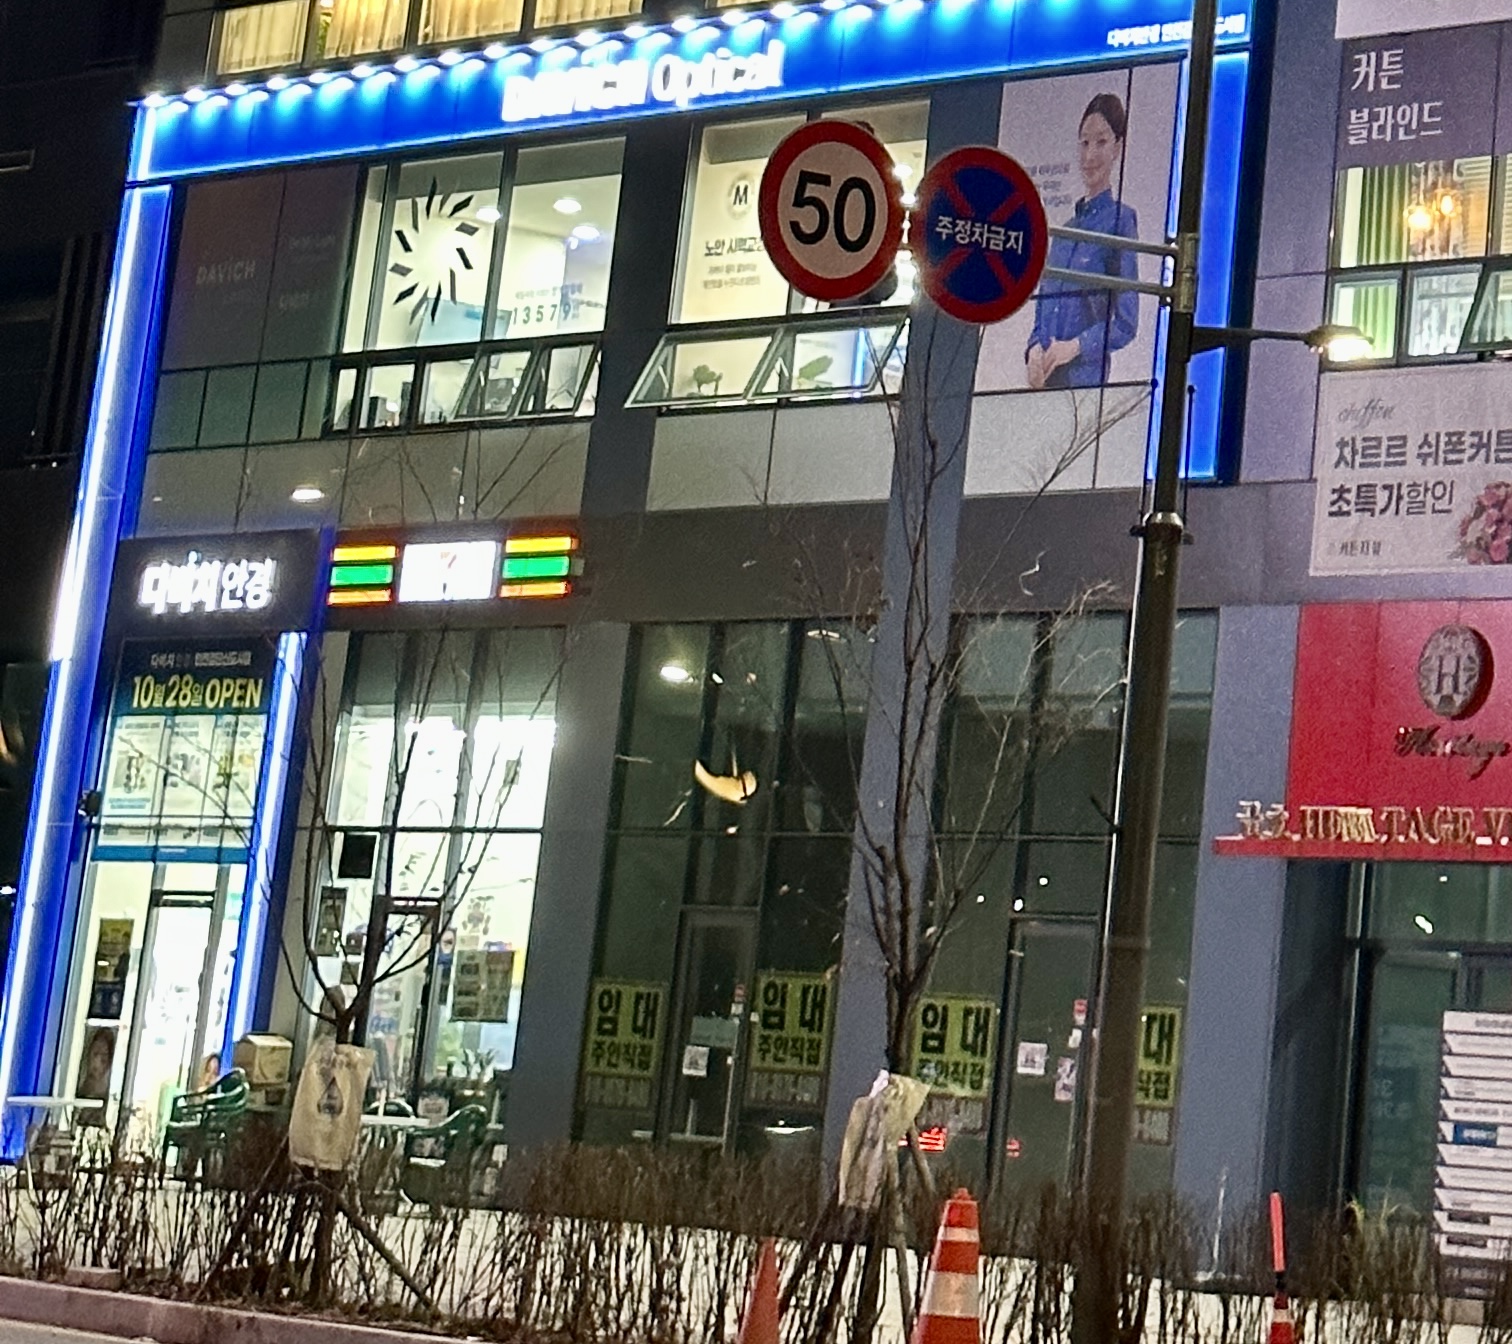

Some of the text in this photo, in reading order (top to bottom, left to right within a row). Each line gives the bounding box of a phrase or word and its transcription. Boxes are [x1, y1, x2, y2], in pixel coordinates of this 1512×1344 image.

[1351, 48, 1405, 92] 커튼
[1346, 100, 1444, 146] 블라인드
[788, 169, 876, 254] 50
[935, 214, 1024, 255] 주정차금지
[1334, 433, 1409, 470] 차르르
[1327, 479, 1456, 518] 초특가할인
[205, 677, 263, 710] OPEN
